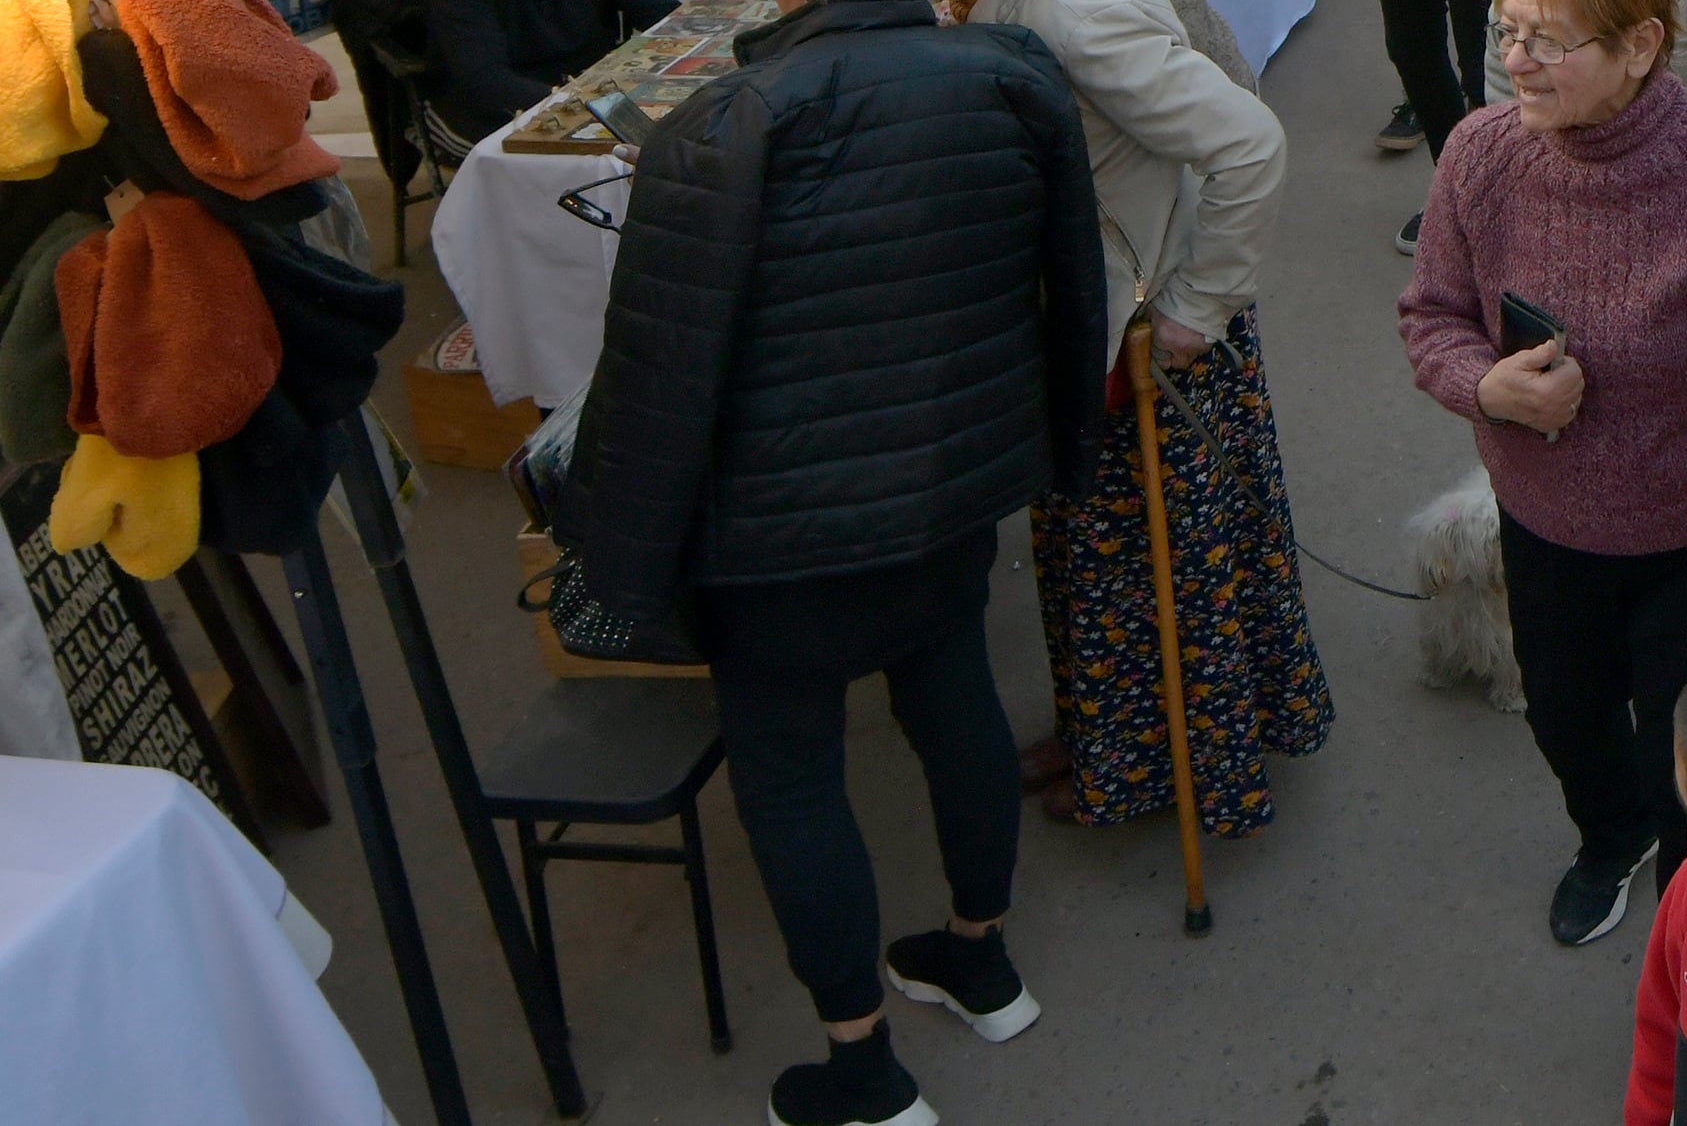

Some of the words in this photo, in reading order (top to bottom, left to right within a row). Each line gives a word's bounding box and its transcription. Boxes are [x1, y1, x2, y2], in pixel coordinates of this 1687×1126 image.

[68, 655, 112, 716] PINOT
[106, 620, 144, 673] NOIR
[82, 643, 161, 752] SHIRAZ
